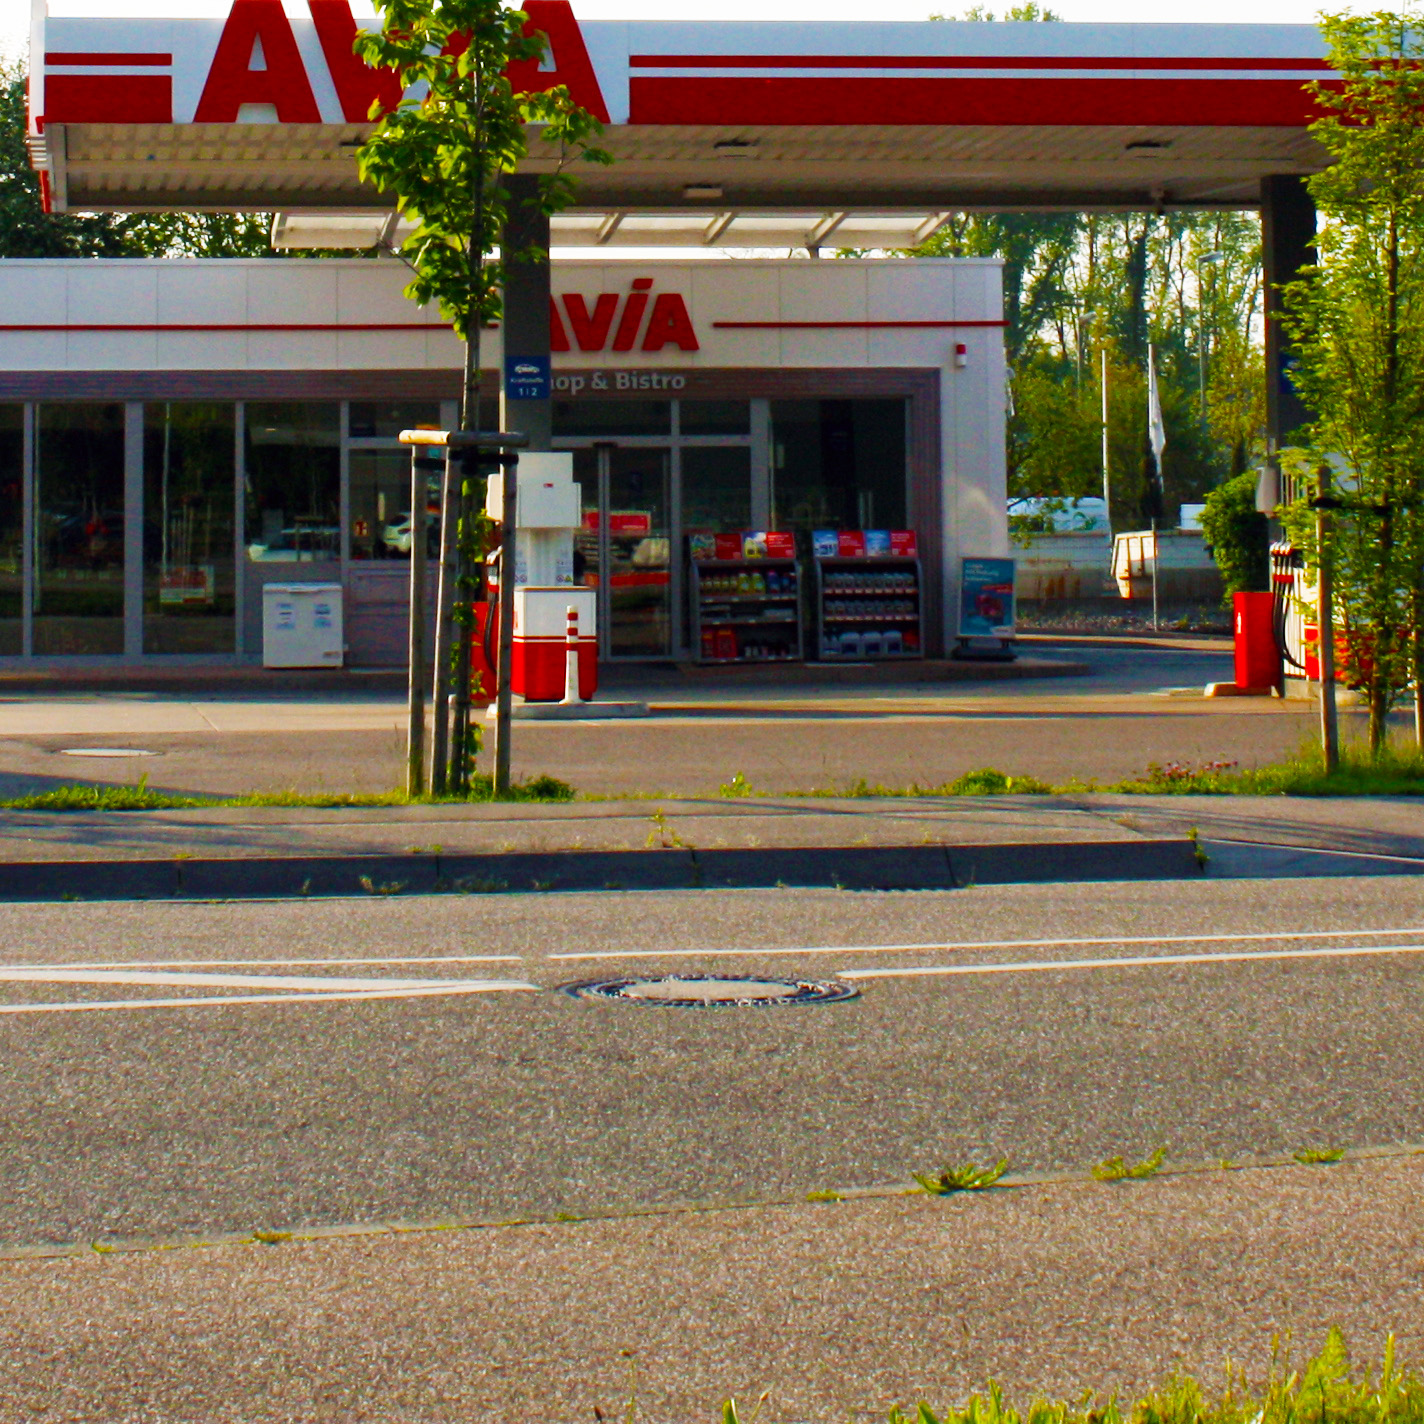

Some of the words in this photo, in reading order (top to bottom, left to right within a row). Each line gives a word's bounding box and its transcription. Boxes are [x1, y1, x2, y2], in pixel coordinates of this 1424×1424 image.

[550, 375, 585, 395] op
[591, 372, 608, 390] &
[616, 372, 686, 390] Bistro
